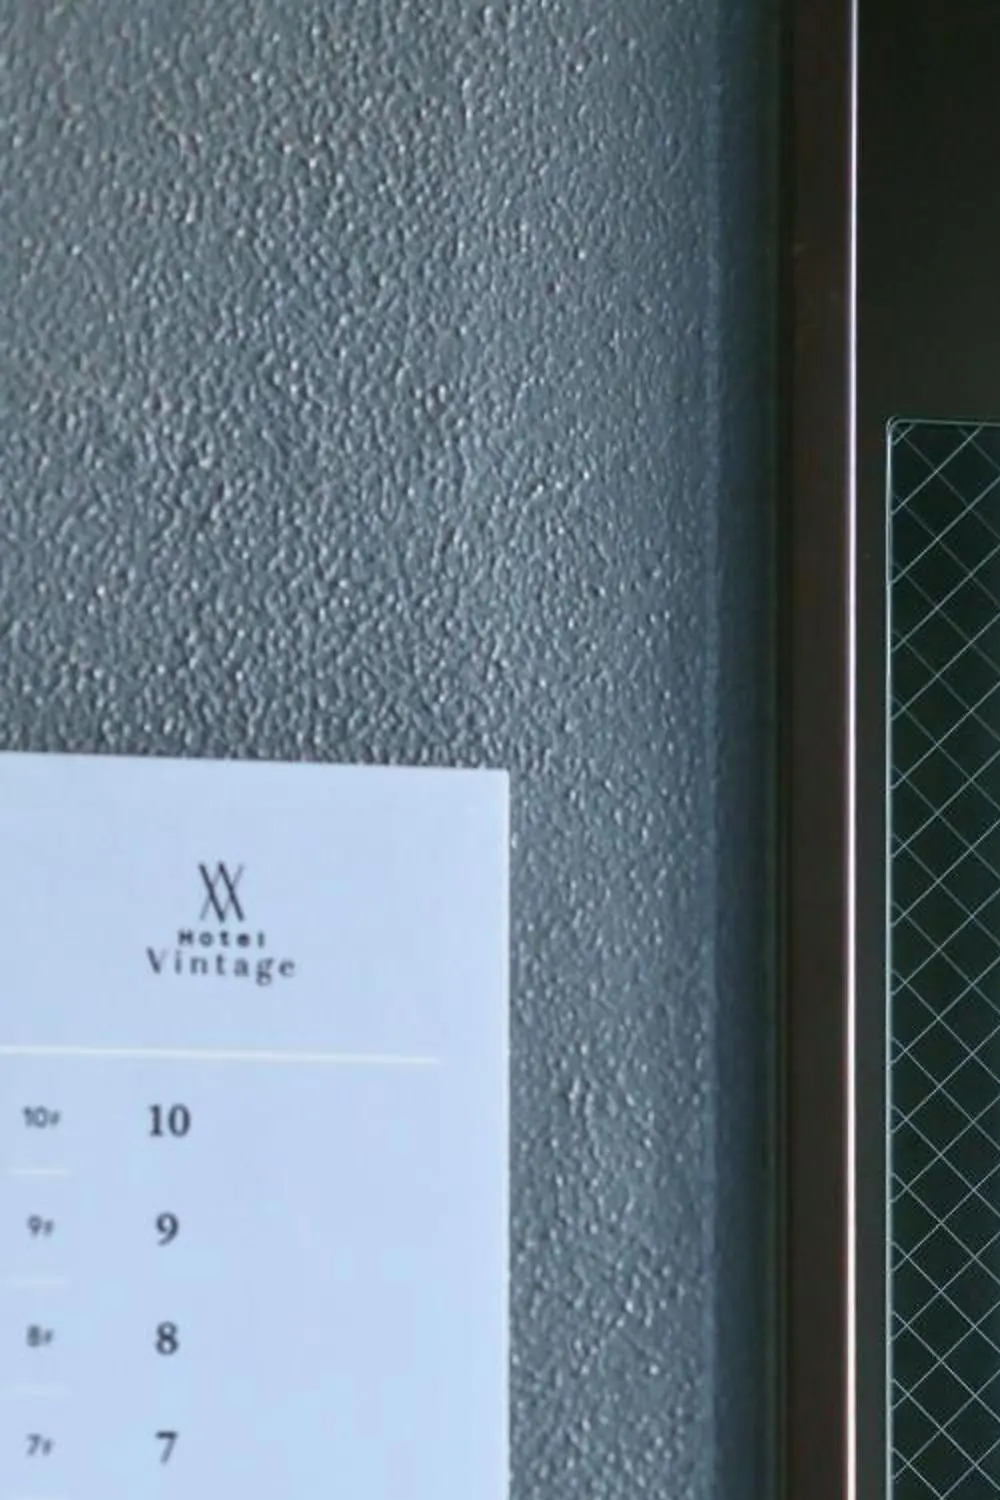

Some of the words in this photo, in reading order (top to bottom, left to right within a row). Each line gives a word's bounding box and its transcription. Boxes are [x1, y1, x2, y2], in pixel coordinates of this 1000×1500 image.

[177, 929, 266, 949] Hotel
[146, 947, 296, 987] Vintage
[148, 1103, 192, 1138] 10
[155, 1211, 180, 1246] 9
[154, 1321, 180, 1356] 8
[155, 1430, 179, 1465] 7
